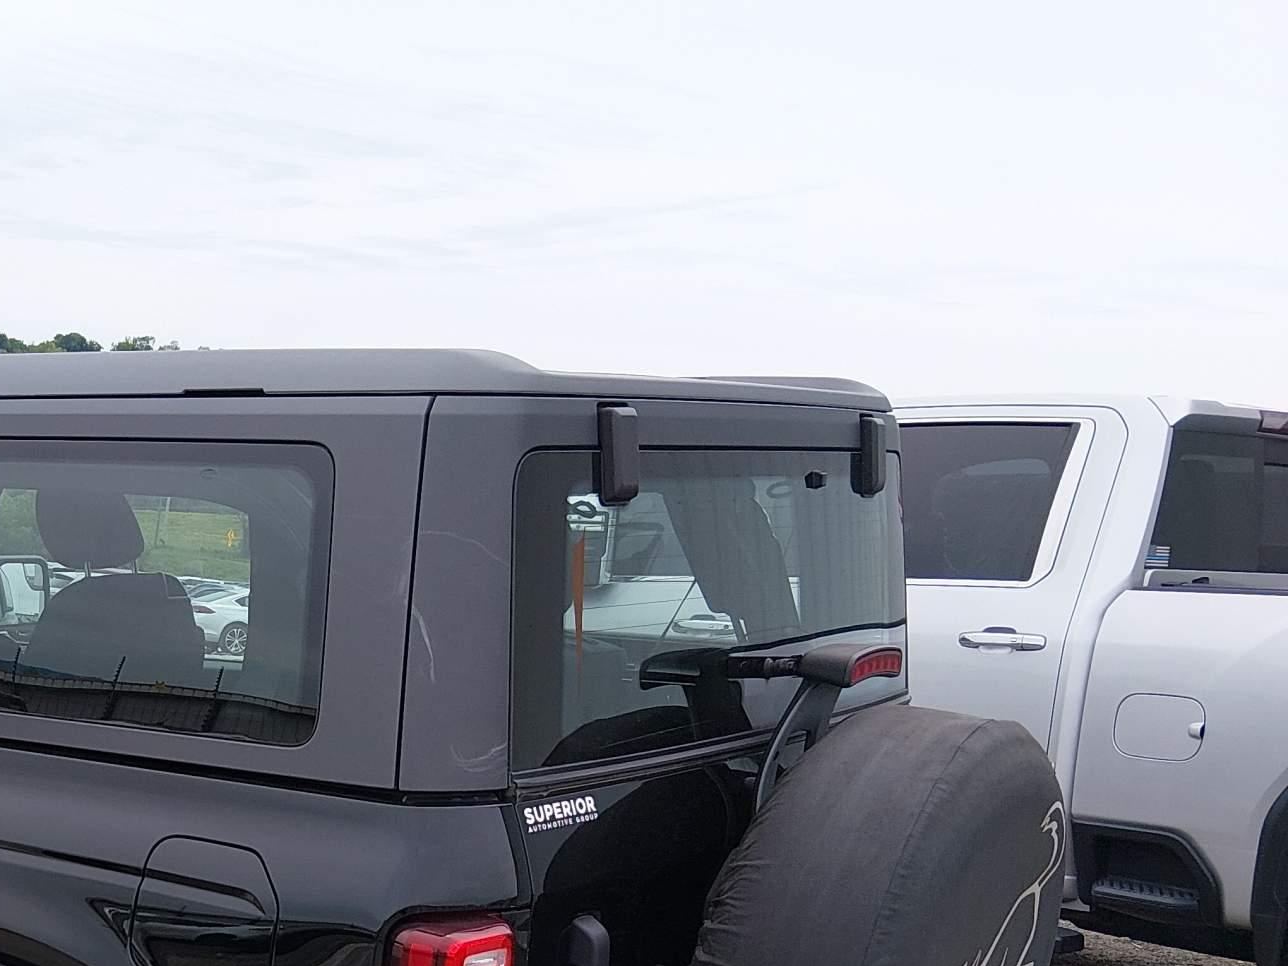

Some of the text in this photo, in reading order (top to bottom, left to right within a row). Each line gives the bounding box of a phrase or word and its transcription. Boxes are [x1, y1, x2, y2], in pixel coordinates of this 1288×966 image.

[523, 795, 597, 825] SUPERIOR
[527, 812, 599, 834] AUTOMOTIVE GROUP
